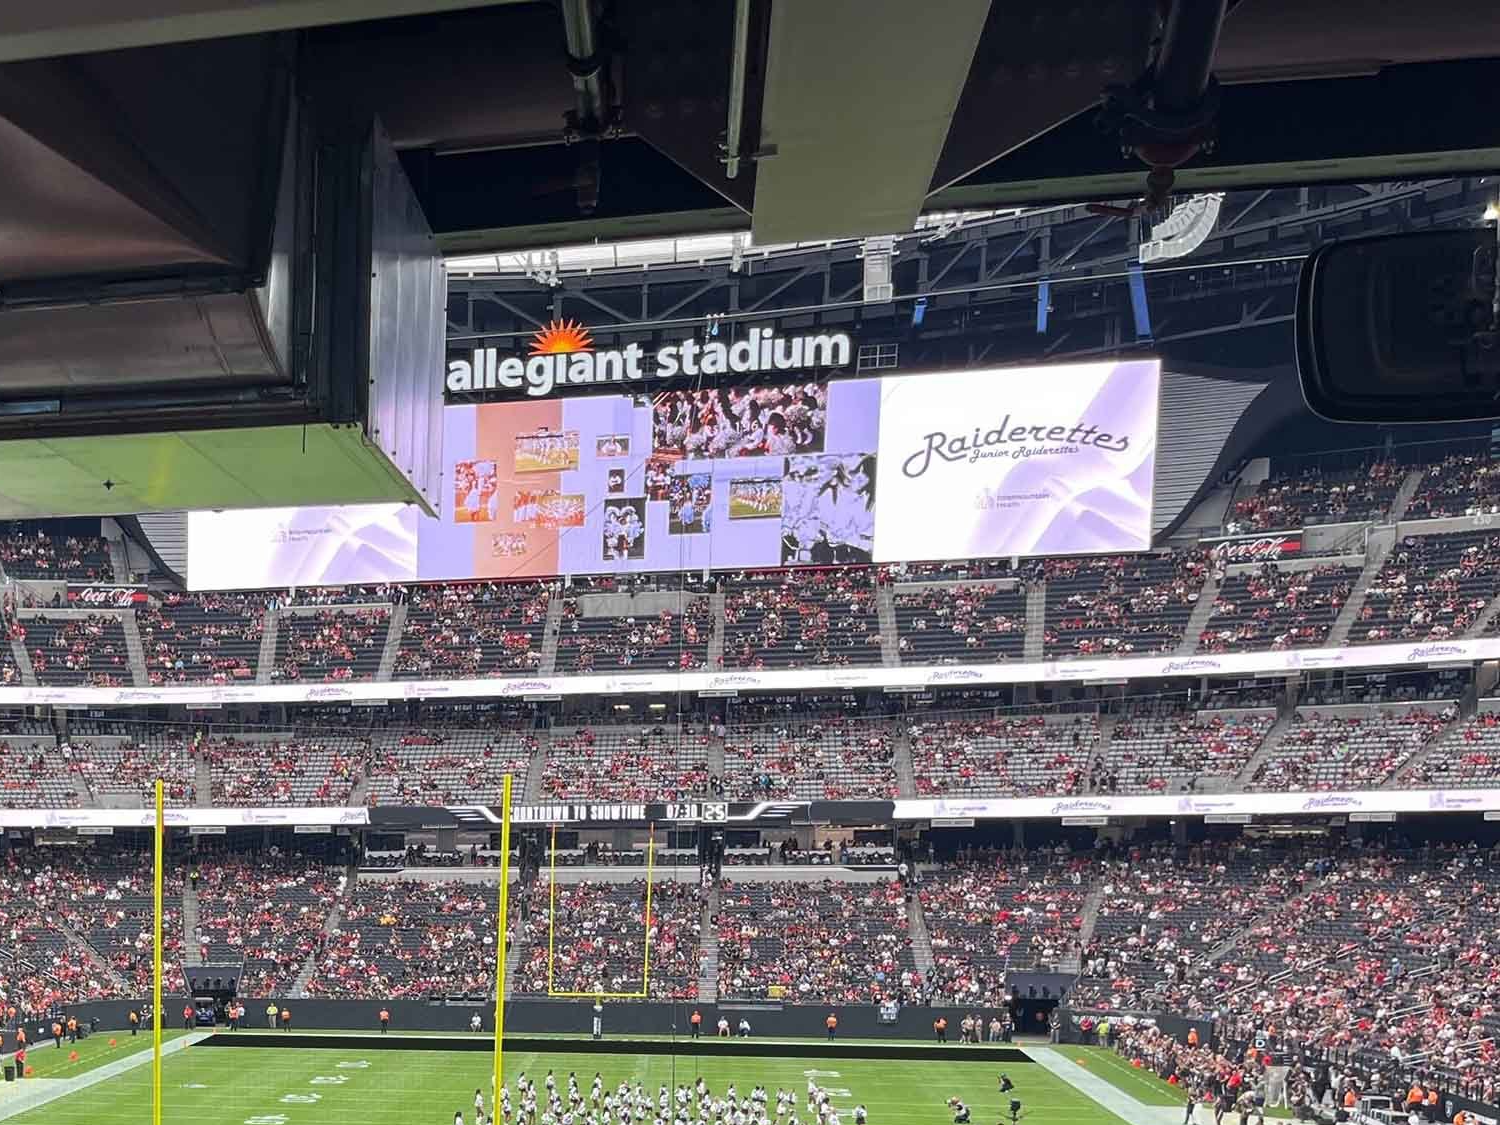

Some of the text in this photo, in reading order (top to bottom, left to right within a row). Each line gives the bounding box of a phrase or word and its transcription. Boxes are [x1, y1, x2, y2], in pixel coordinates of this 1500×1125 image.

[446, 327, 851, 395] allegiant stadium
[901, 414, 1130, 478] Raiderettes
[969, 448, 1010, 463] Junior
[574, 805, 586, 820] TO
[590, 804, 647, 820] SHOWTIME
[666, 803, 698, 819] 07:30
